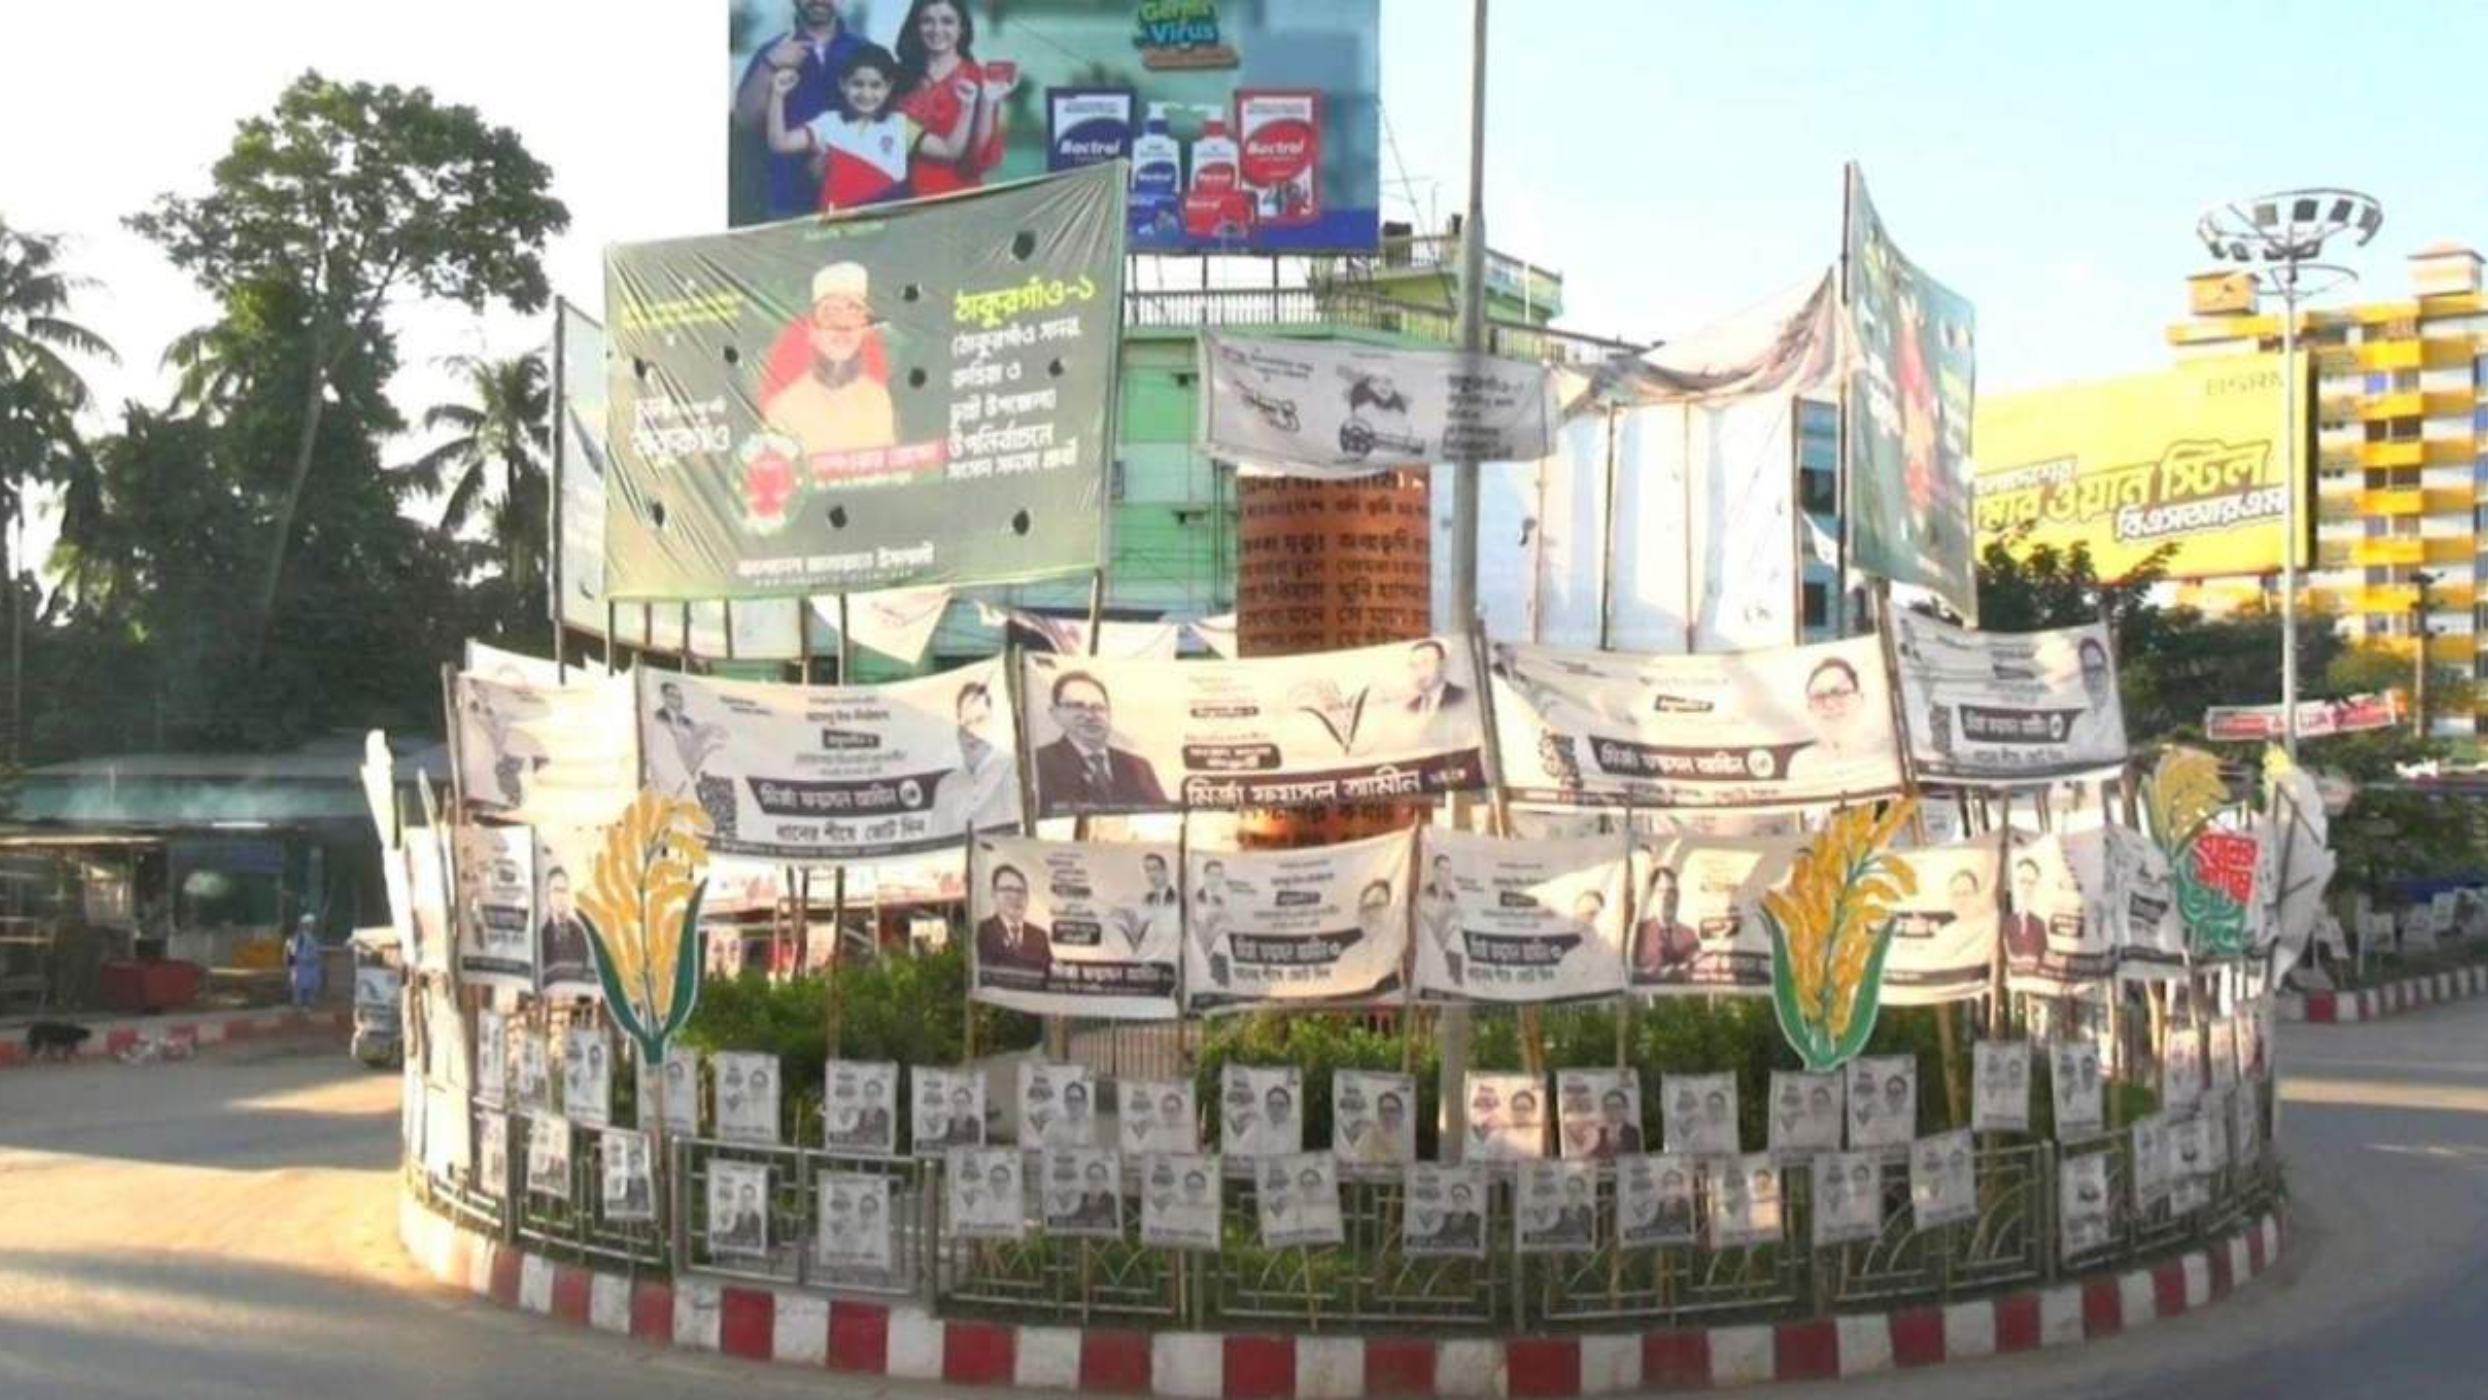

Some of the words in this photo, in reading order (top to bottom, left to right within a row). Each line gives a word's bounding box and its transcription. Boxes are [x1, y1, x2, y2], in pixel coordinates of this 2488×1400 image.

[1149, 22, 1215, 42] Virus
[1060, 139, 1121, 156] Bactrol
[1246, 139, 1304, 156] Bactrol
[953, 274, 1095, 328] ঠাকুরগাঁও-১
[2046, 462, 2157, 523] ওয়ান
[2161, 440, 2270, 502] স্টিল
[1186, 778, 1243, 809] মির্জা
